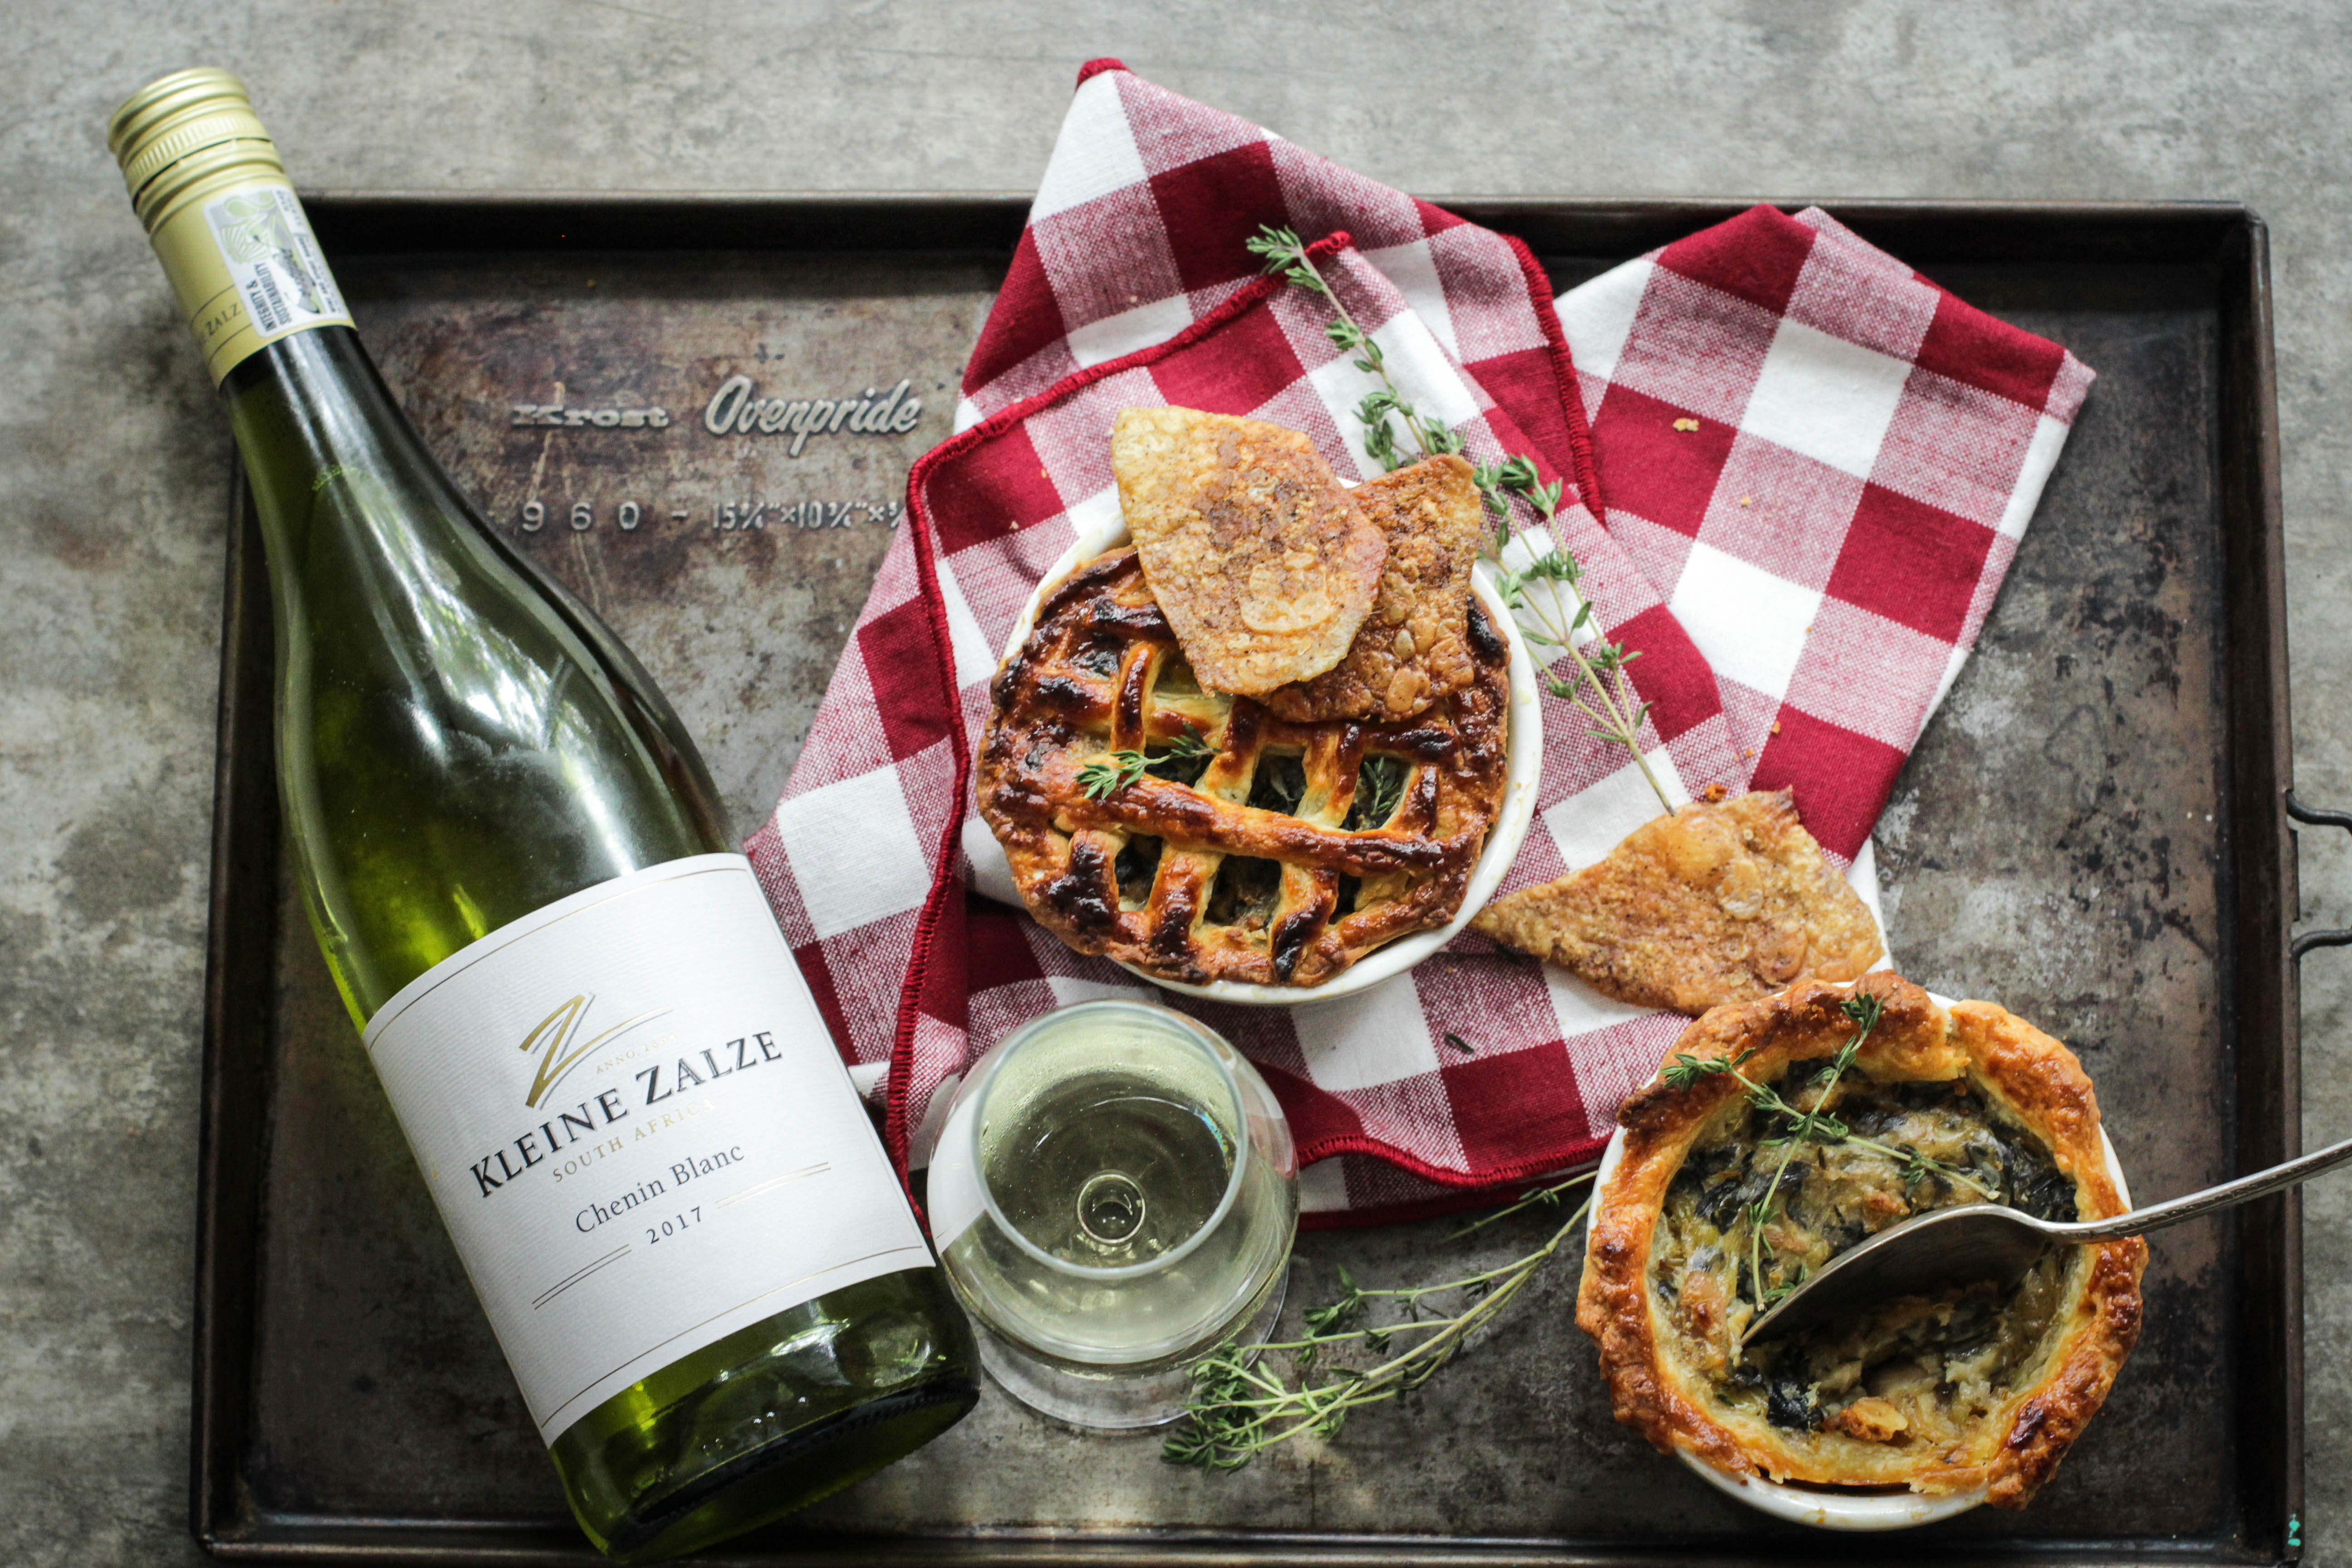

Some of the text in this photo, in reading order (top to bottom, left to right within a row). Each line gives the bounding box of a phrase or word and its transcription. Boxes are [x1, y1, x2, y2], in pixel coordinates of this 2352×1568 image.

[206, 302, 242, 336] ZALZ
[245, 279, 276, 332] INTEGRITY &
[254, 262, 292, 325] SUSTAINABILITY
[705, 374, 921, 457] Ovenpride
[469, 1030, 782, 1198] KLEINE ZALZE
[553, 1098, 715, 1183] SOUTH AFRICA
[576, 1146, 745, 1233] Chenin Blanc
[646, 1205, 702, 1245] 2017
